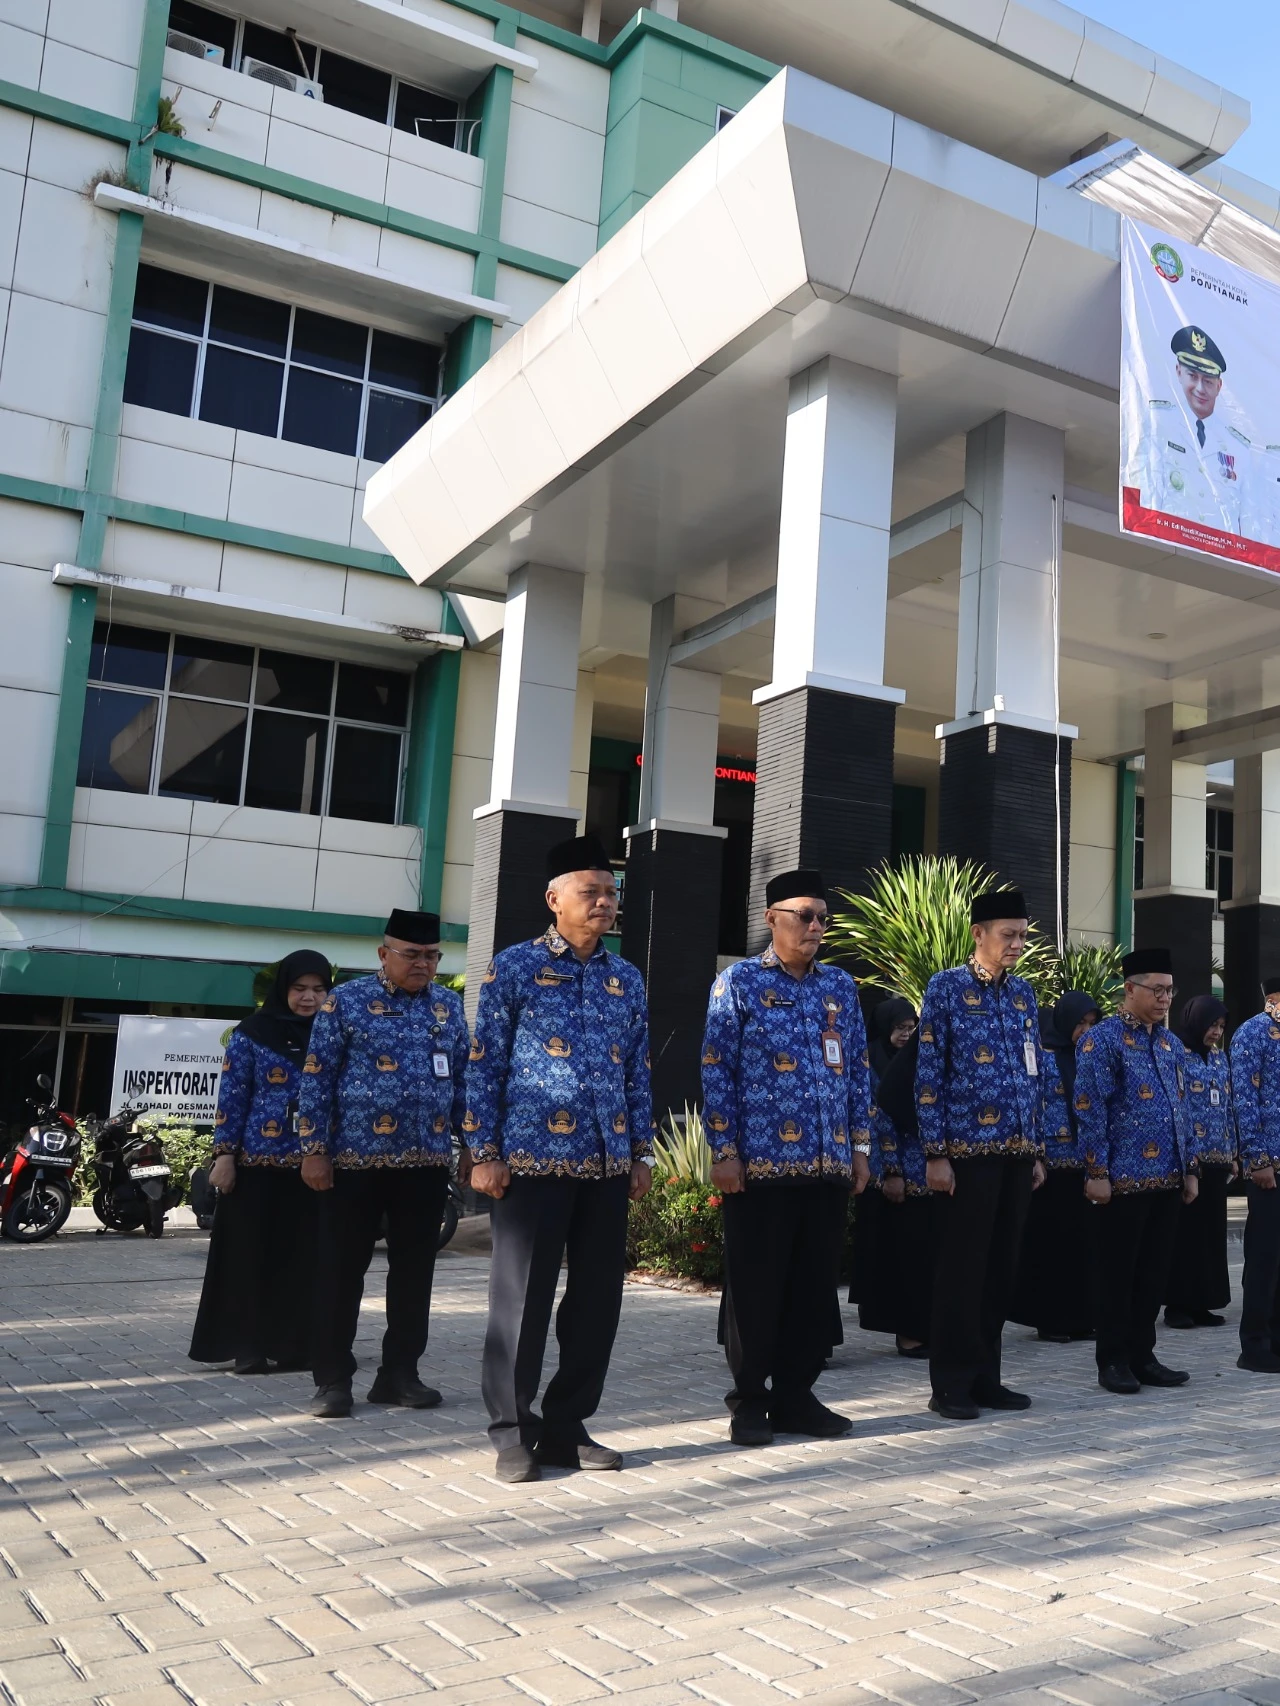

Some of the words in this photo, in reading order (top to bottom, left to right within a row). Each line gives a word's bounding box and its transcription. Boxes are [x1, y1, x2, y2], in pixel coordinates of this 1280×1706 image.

[1190, 267, 1231, 290] PEMERINTAH
[1190, 275, 1249, 307] PONTIANAK
[164, 1053, 223, 1064] PEMERINTAH
[123, 1069, 218, 1097] INSPEKTORAT
[177, 1102, 216, 1111] OESMAN
